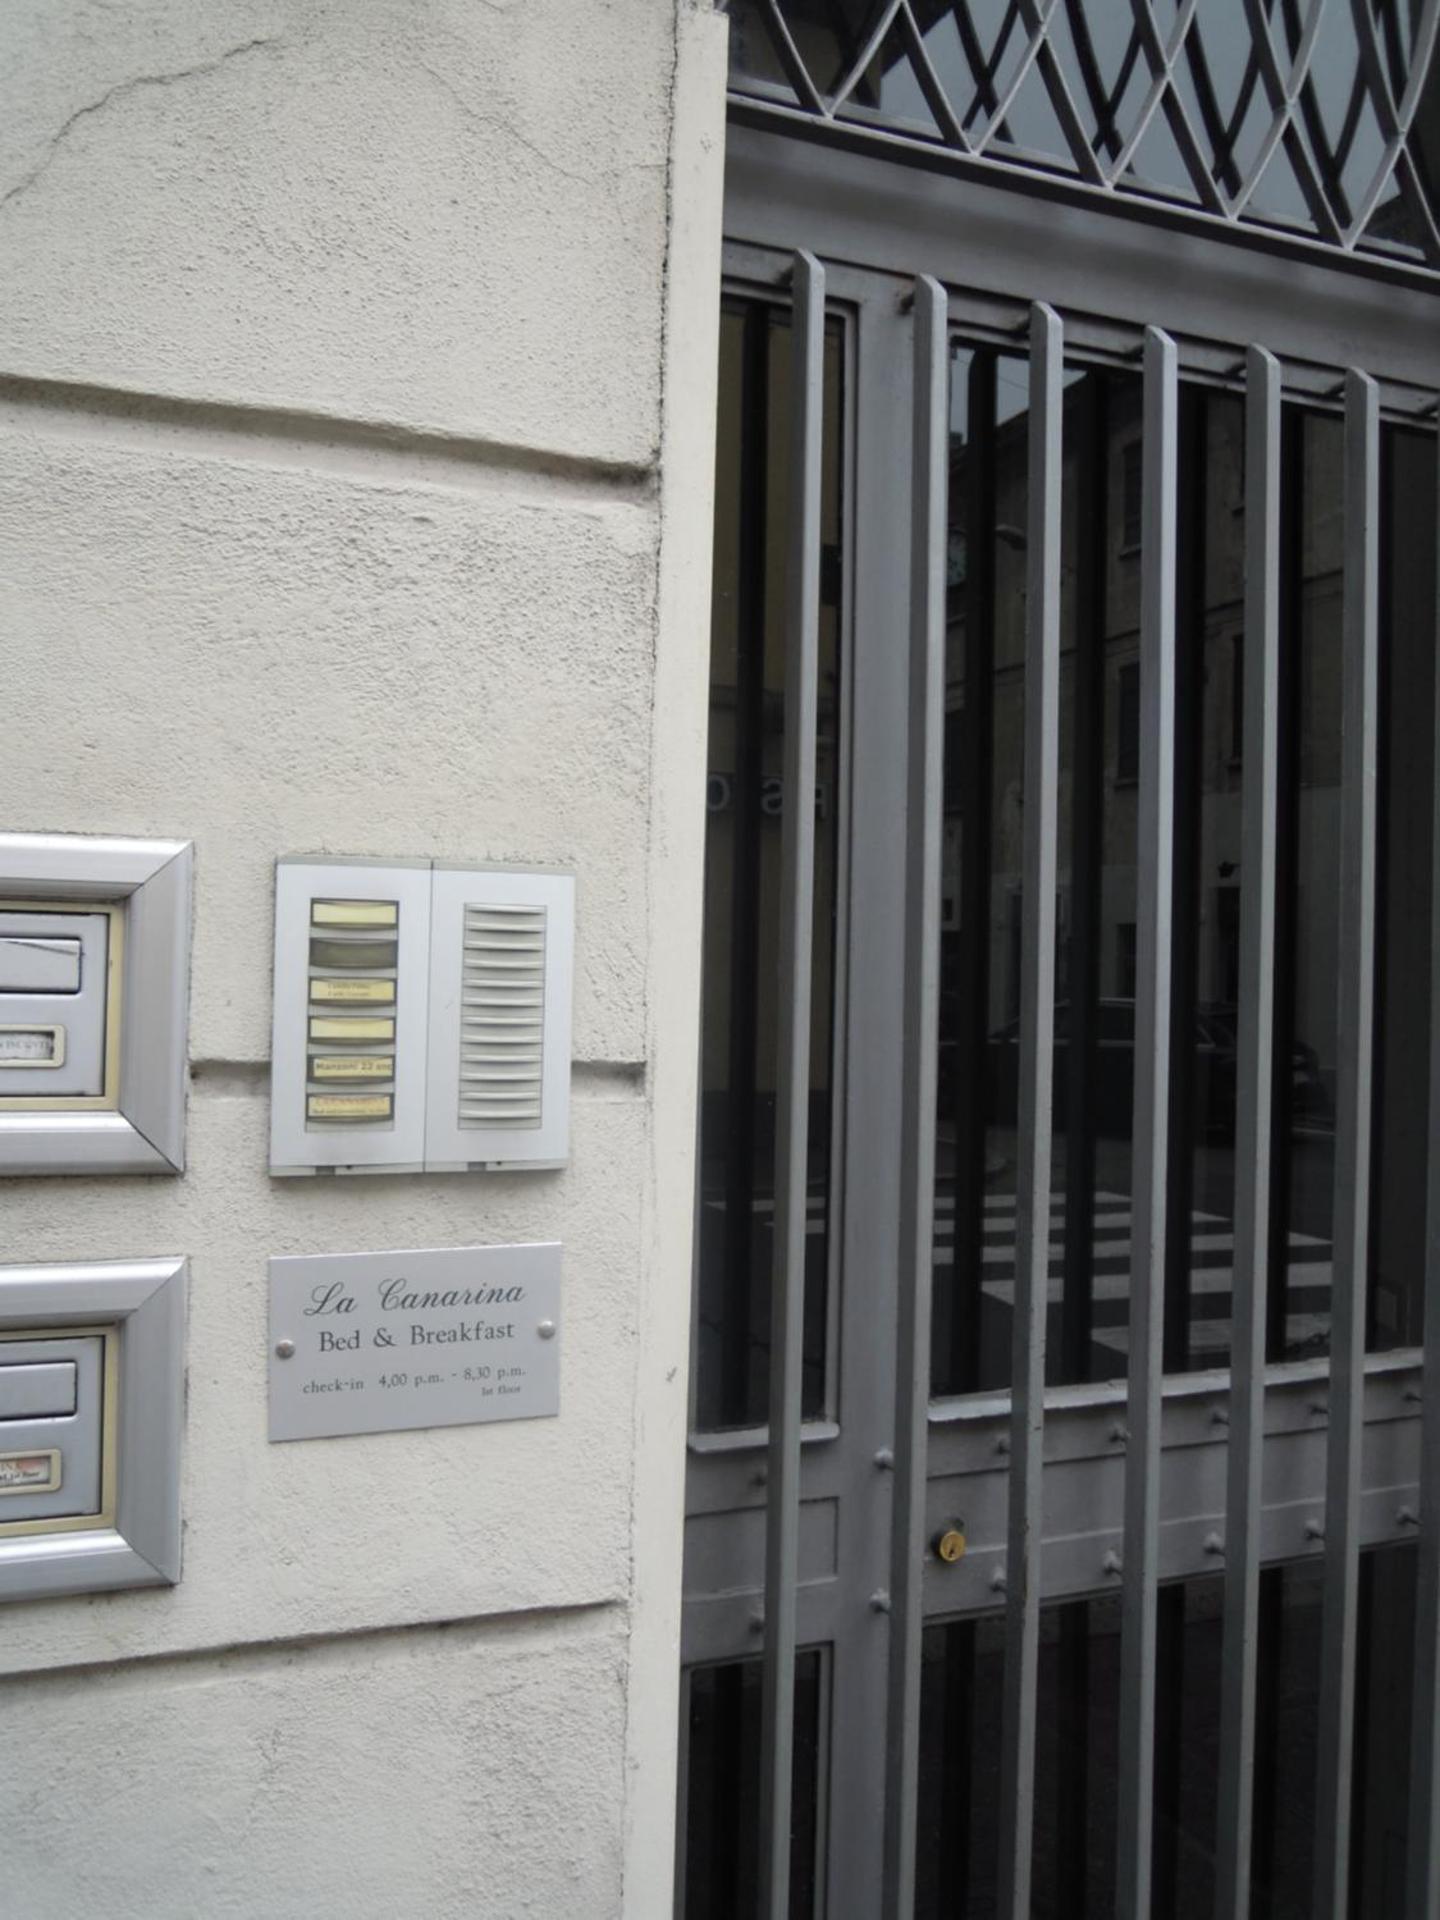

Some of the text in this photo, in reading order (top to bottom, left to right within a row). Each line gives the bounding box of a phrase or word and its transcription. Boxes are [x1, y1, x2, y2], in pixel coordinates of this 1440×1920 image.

[303, 1278, 526, 1316] La Canarina
[319, 1321, 515, 1352] Bed & Breakfast
[302, 1377, 364, 1394] check-in
[378, 1372, 408, 1388] 4,00
[414, 1373, 445, 1387] p.m.
[497, 1367, 526, 1381] p.m.
